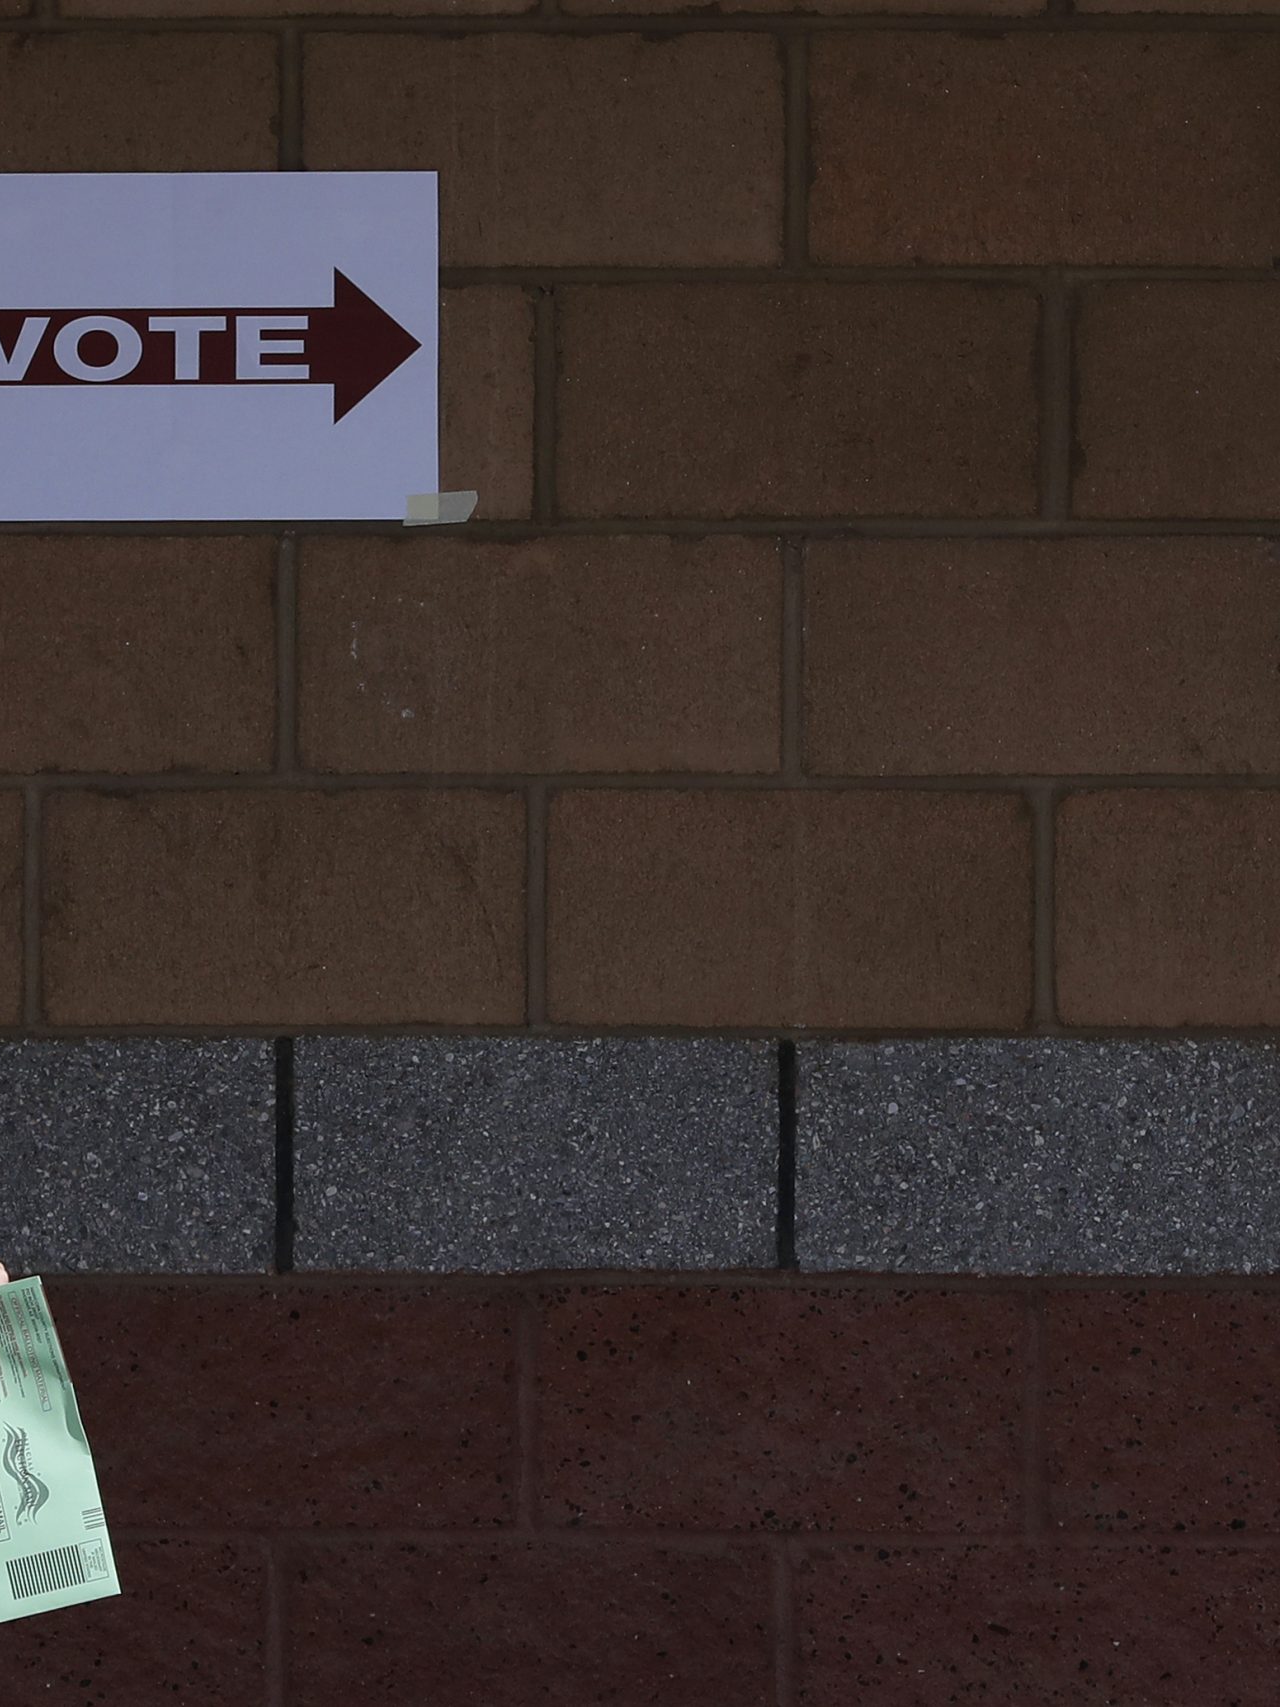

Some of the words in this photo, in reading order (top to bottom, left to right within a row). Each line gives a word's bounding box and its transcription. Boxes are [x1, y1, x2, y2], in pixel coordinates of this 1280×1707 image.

[11, 1297, 26, 1327] OFFICIAL
[23, 1328, 40, 1369] BALLOTING
[35, 1369, 48, 1402] MATERIAL
